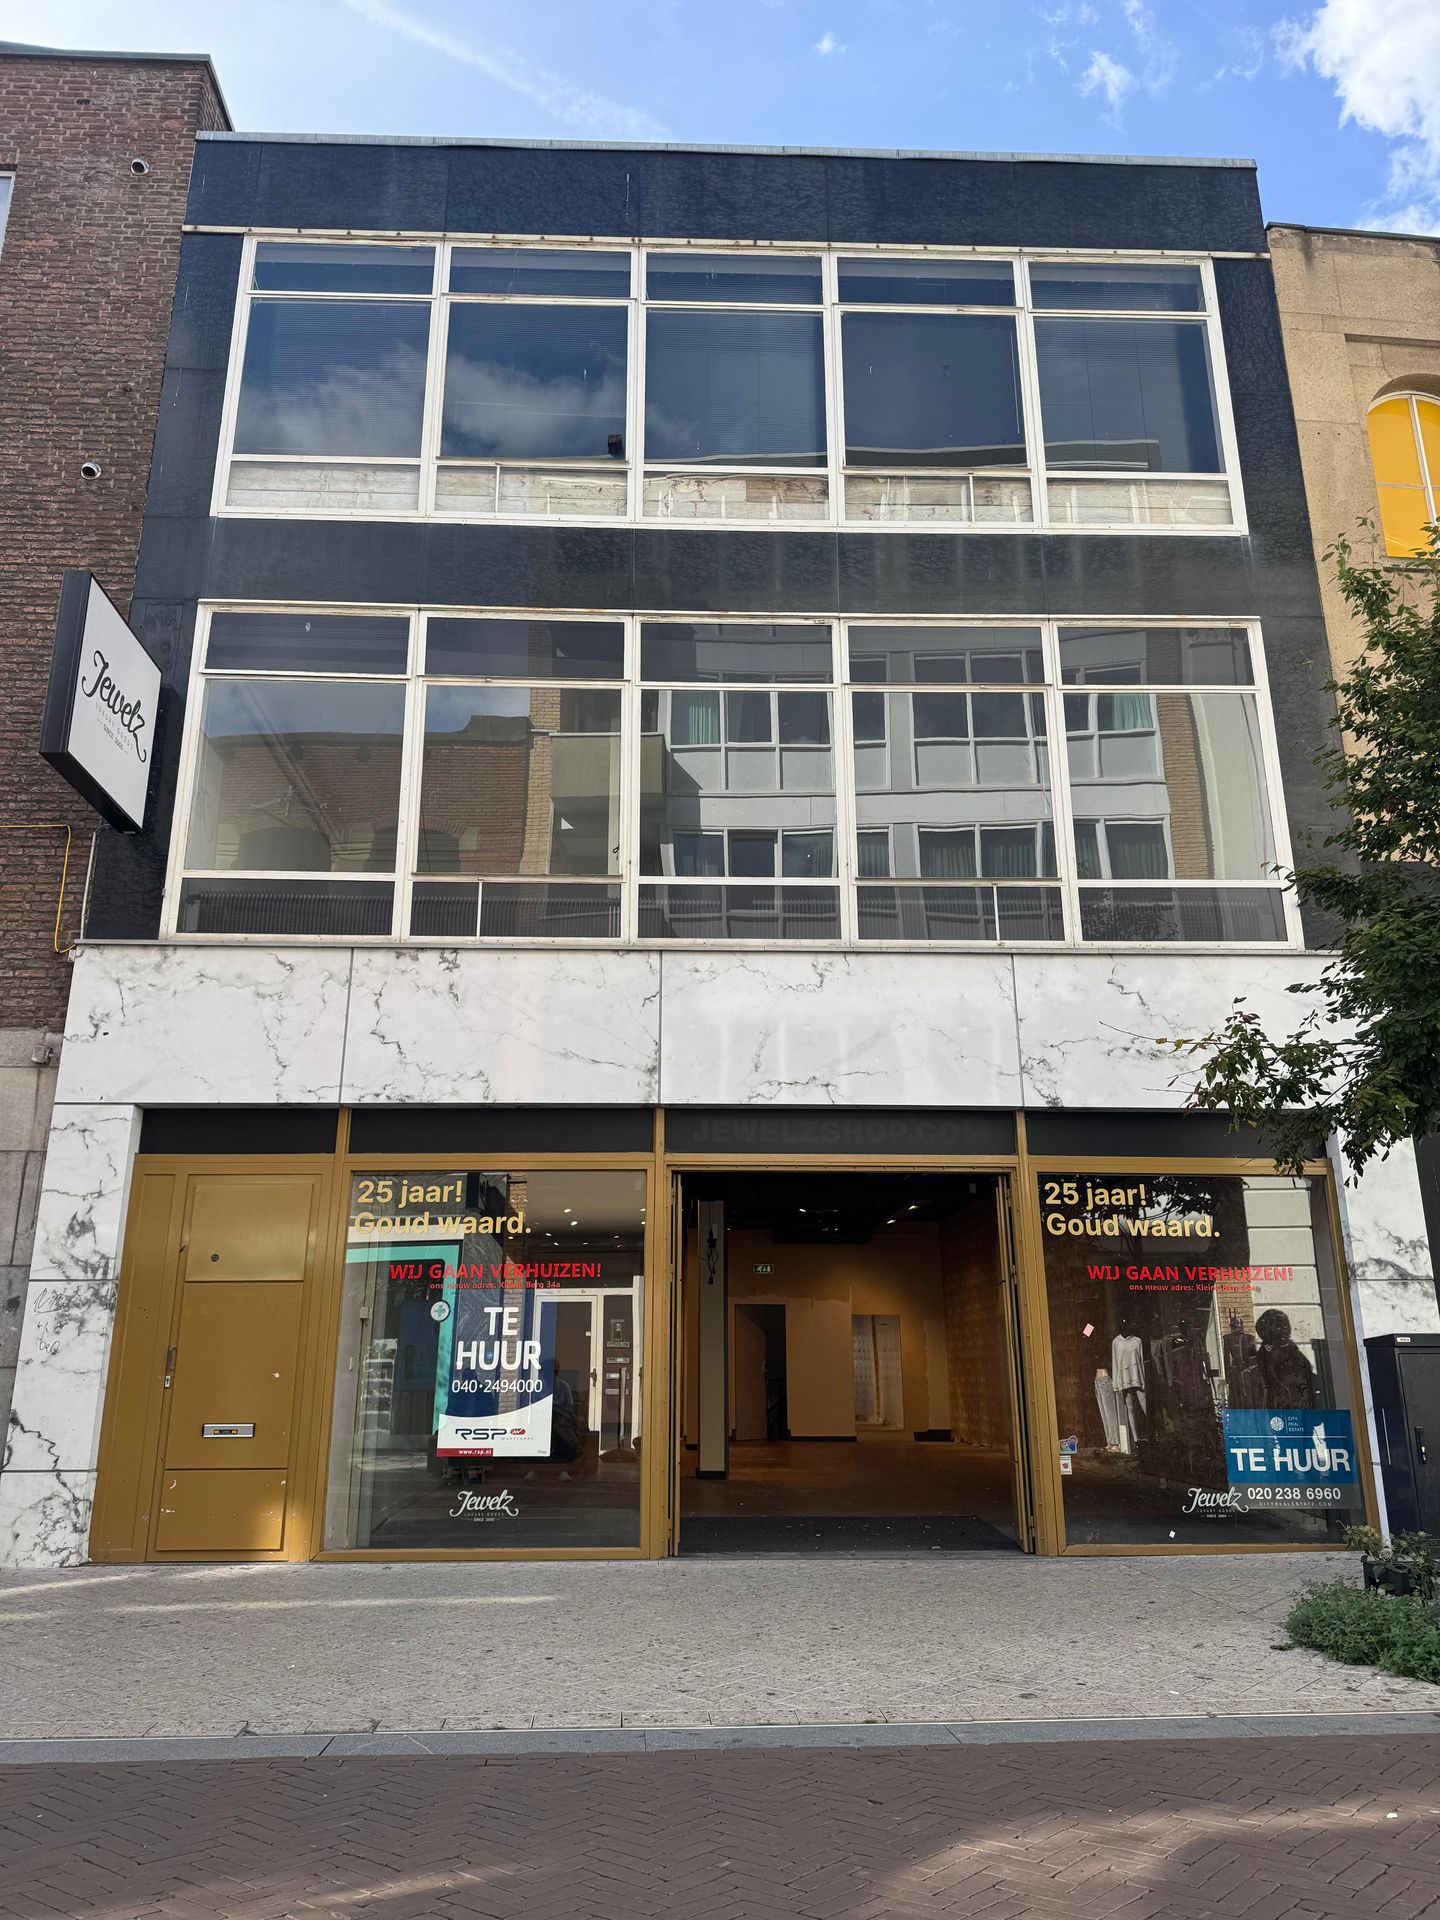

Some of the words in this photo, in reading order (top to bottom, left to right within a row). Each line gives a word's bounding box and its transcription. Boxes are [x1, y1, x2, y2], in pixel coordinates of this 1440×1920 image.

[81, 650, 147, 763] Jewelz
[357, 1180, 393, 1203] 25
[398, 1179, 462, 1208] jaar!
[1044, 1182, 1079, 1205] 25
[1086, 1182, 1147, 1210] jaar!
[354, 1211, 430, 1234] Goud
[437, 1211, 532, 1234] waard.
[1046, 1213, 1120, 1236] Goud
[1126, 1215, 1220, 1237] waard.
[389, 1264, 423, 1280] WIJ
[428, 1263, 483, 1279] GAAN
[490, 1262, 601, 1279] VERHUIZEN!
[1087, 1265, 1120, 1281] WIJ
[1125, 1265, 1180, 1281] GAAN
[1184, 1266, 1294, 1281] VERHUIZEN!
[1145, 1283, 1169, 1291] nieuw
[1170, 1283, 1195, 1291] adres:
[483, 1306, 520, 1336] TE
[456, 1340, 542, 1371] HUUR
[455, 1428, 508, 1441] RSP
[458, 1448, 492, 1456] www.rsp.nl
[1230, 1448, 1267, 1472] TE
[1273, 1448, 1351, 1472] HUUR
[449, 1489, 519, 1517] Jewelz
[1182, 1486, 1249, 1513] Jewelz
[1247, 1487, 1272, 1500] 020
[1275, 1487, 1301, 1500] 238
[1306, 1487, 1341, 1500] 6960
